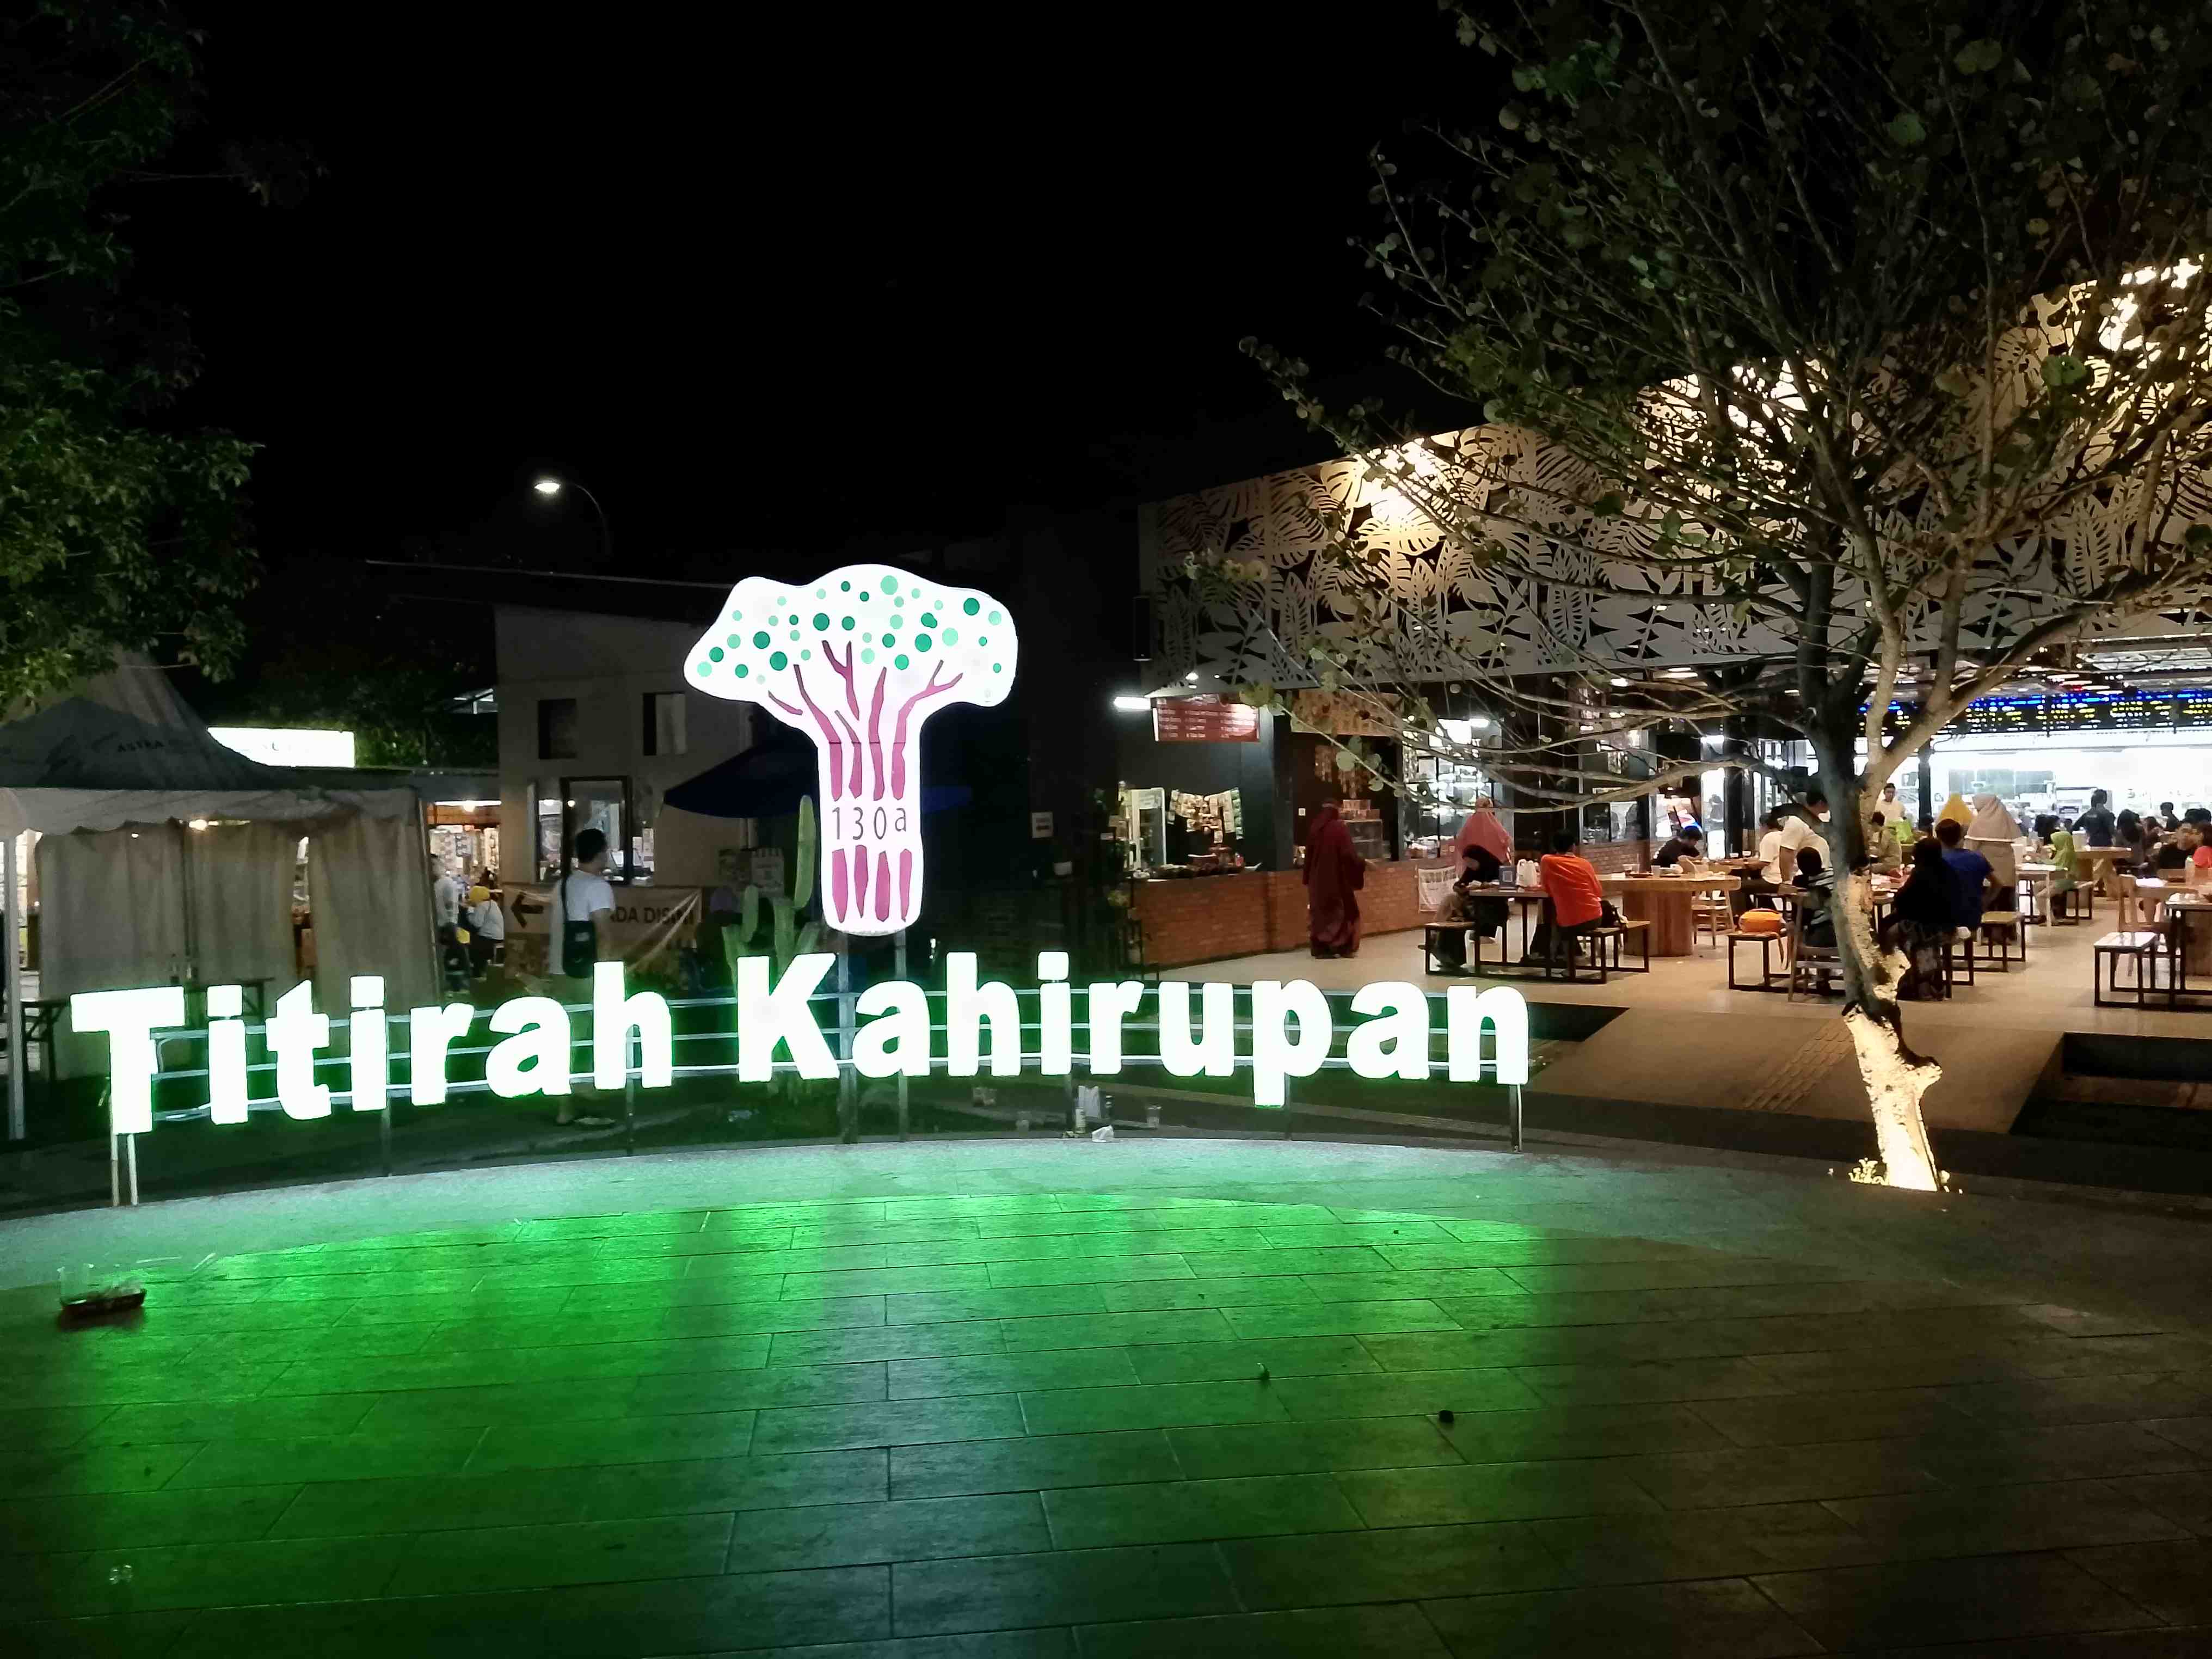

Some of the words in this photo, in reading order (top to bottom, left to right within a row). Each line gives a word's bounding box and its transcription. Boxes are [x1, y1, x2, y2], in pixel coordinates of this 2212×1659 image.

[832, 806, 906, 840] 130a
[610, 906, 639, 923] DA
[70, 961, 675, 1134] Titirah
[733, 951, 1528, 1105] Kahirupan
